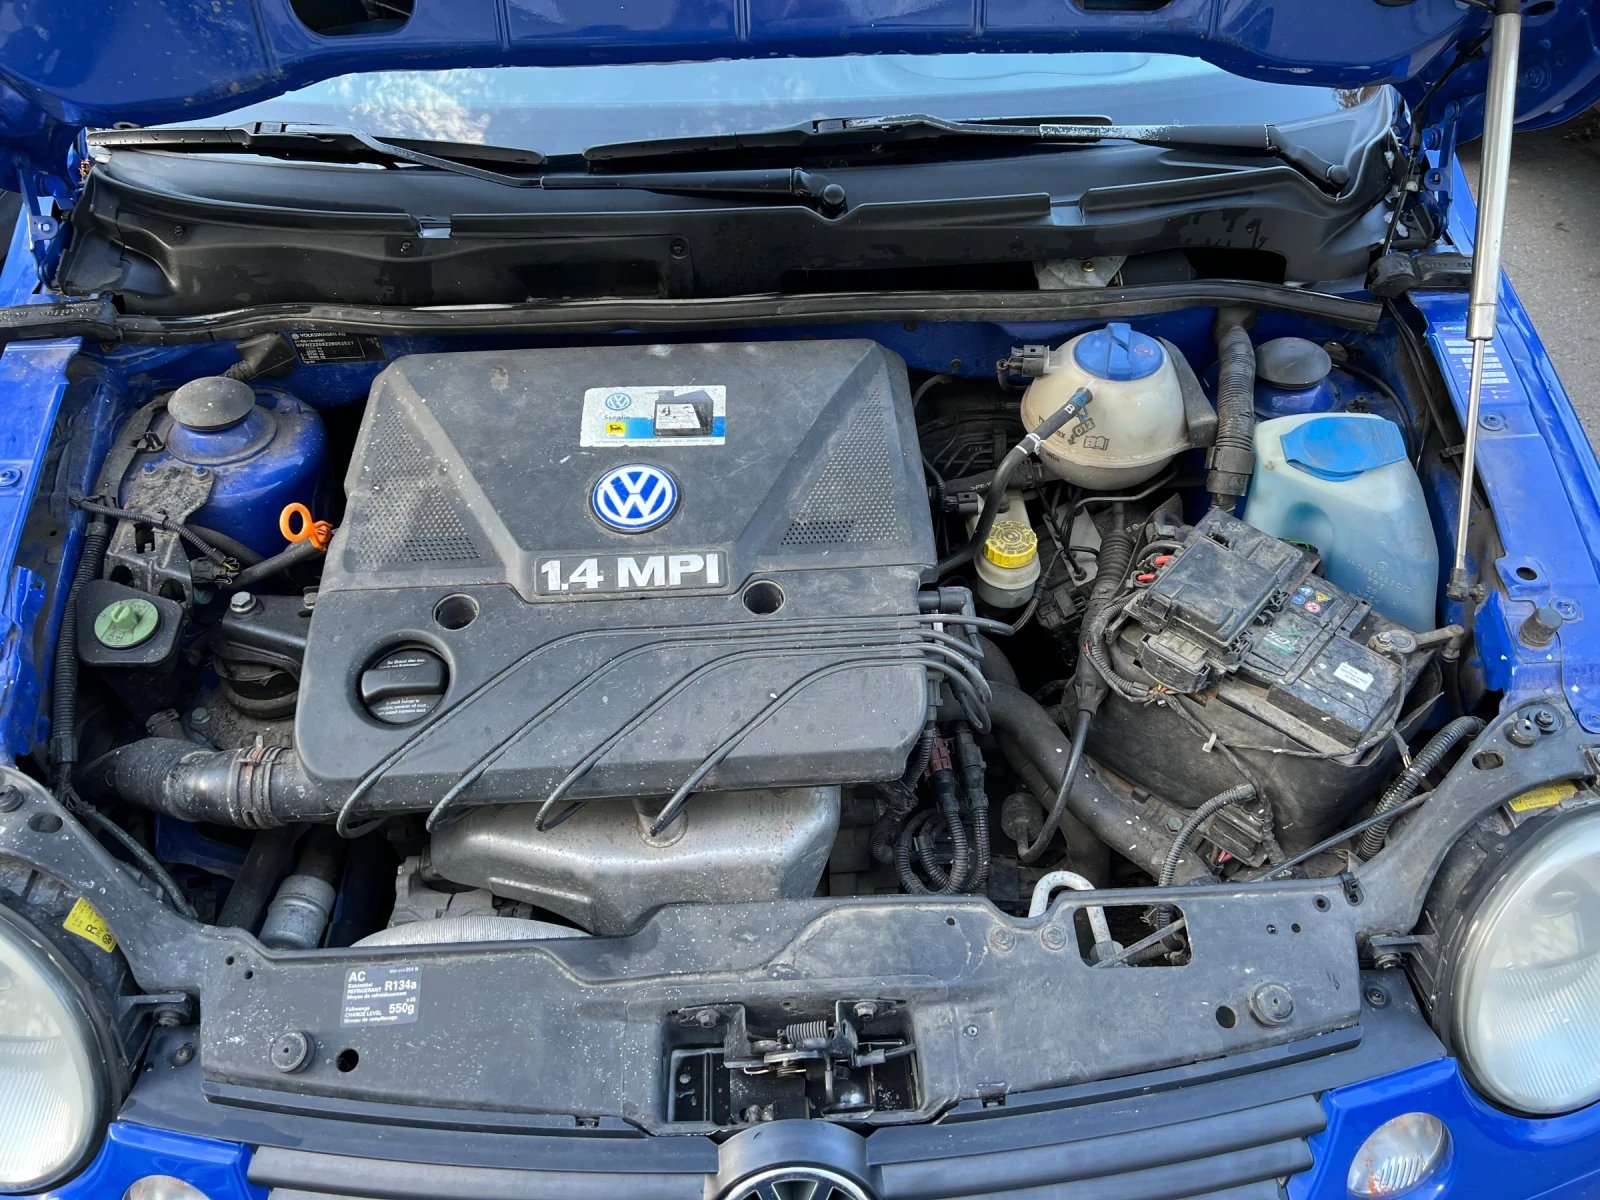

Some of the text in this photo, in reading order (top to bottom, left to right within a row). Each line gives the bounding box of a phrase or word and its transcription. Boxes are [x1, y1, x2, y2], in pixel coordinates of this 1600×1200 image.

[1075, 420, 1093, 434] G12
[593, 464, 678, 529] VW
[541, 553, 720, 591] 1.4 MPI
[348, 971, 366, 982] AC
[347, 979, 417, 994] REFRIGERANT R134a
[344, 1010, 365, 1018] CHARGE
[388, 1002, 415, 1015] 550g
